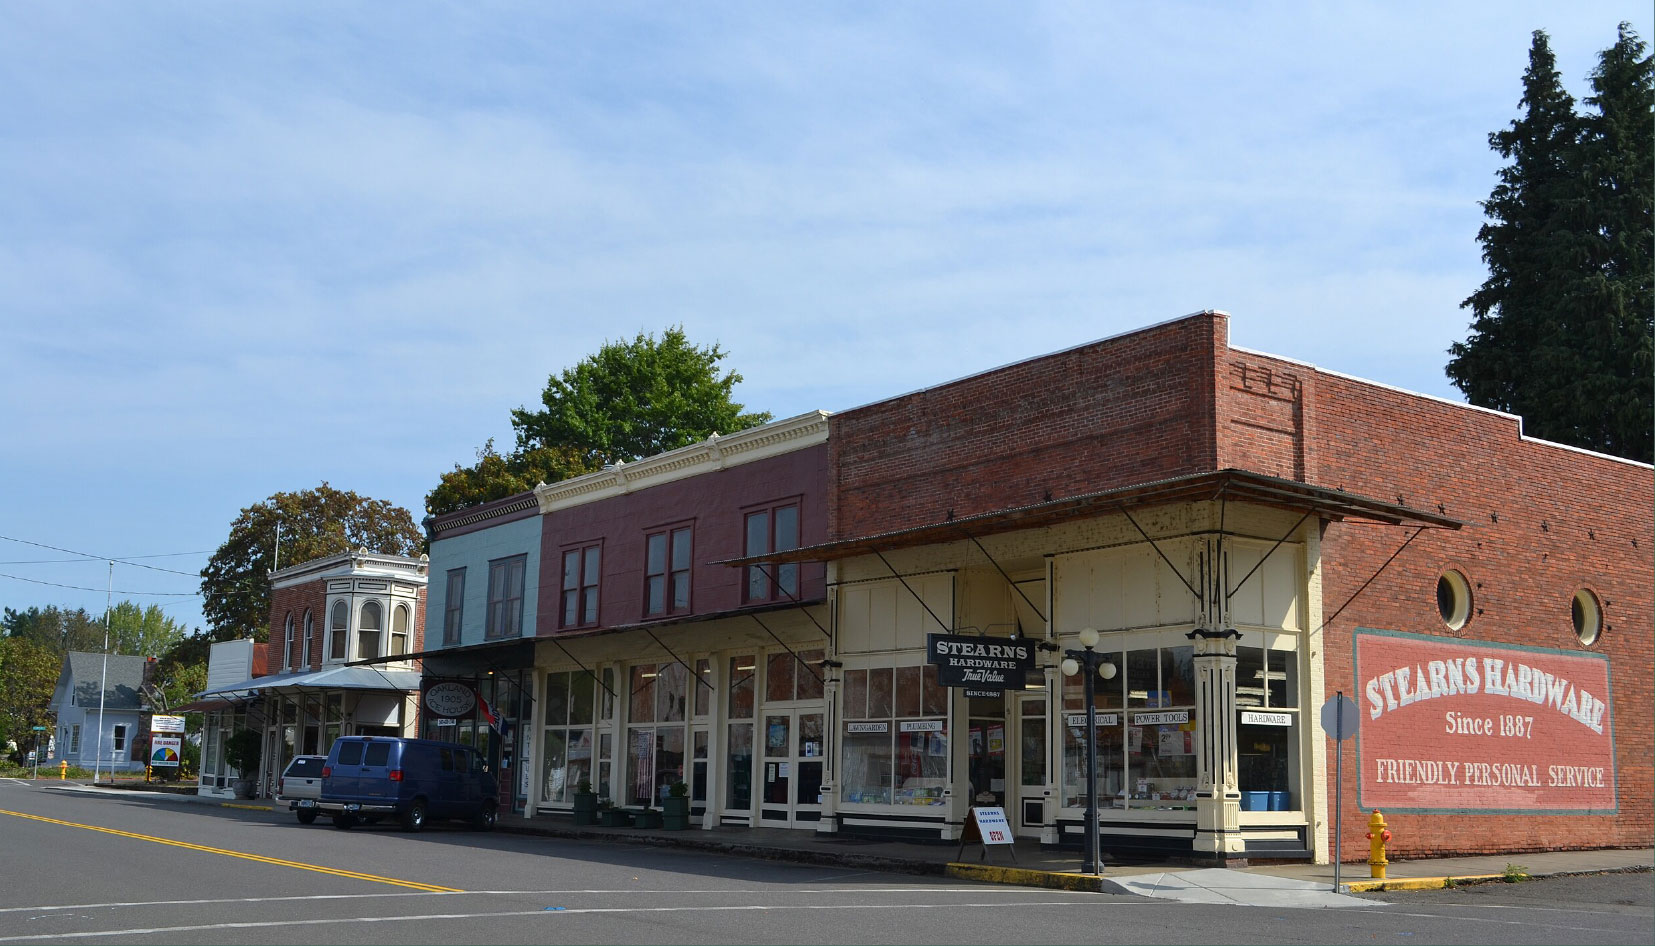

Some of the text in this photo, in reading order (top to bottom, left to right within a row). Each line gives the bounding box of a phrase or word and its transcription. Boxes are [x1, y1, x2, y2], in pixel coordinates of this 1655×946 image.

[936, 641, 1028, 660] STEARNS
[949, 658, 1016, 669] HARDWARE
[430, 684, 472, 698] OAKLAND
[1366, 657, 1605, 735] STEARNS HARDWARE
[429, 698, 474, 714] ICE HOUSE
[441, 695, 462, 703] 1905
[1135, 713, 1188, 724] POWER TOOLS
[1248, 714, 1286, 724] HARDWARE
[1445, 711, 1533, 739] Since 1887
[1463, 762, 1541, 787] PERSONAL
[1548, 765, 1605, 787] SERVICE
